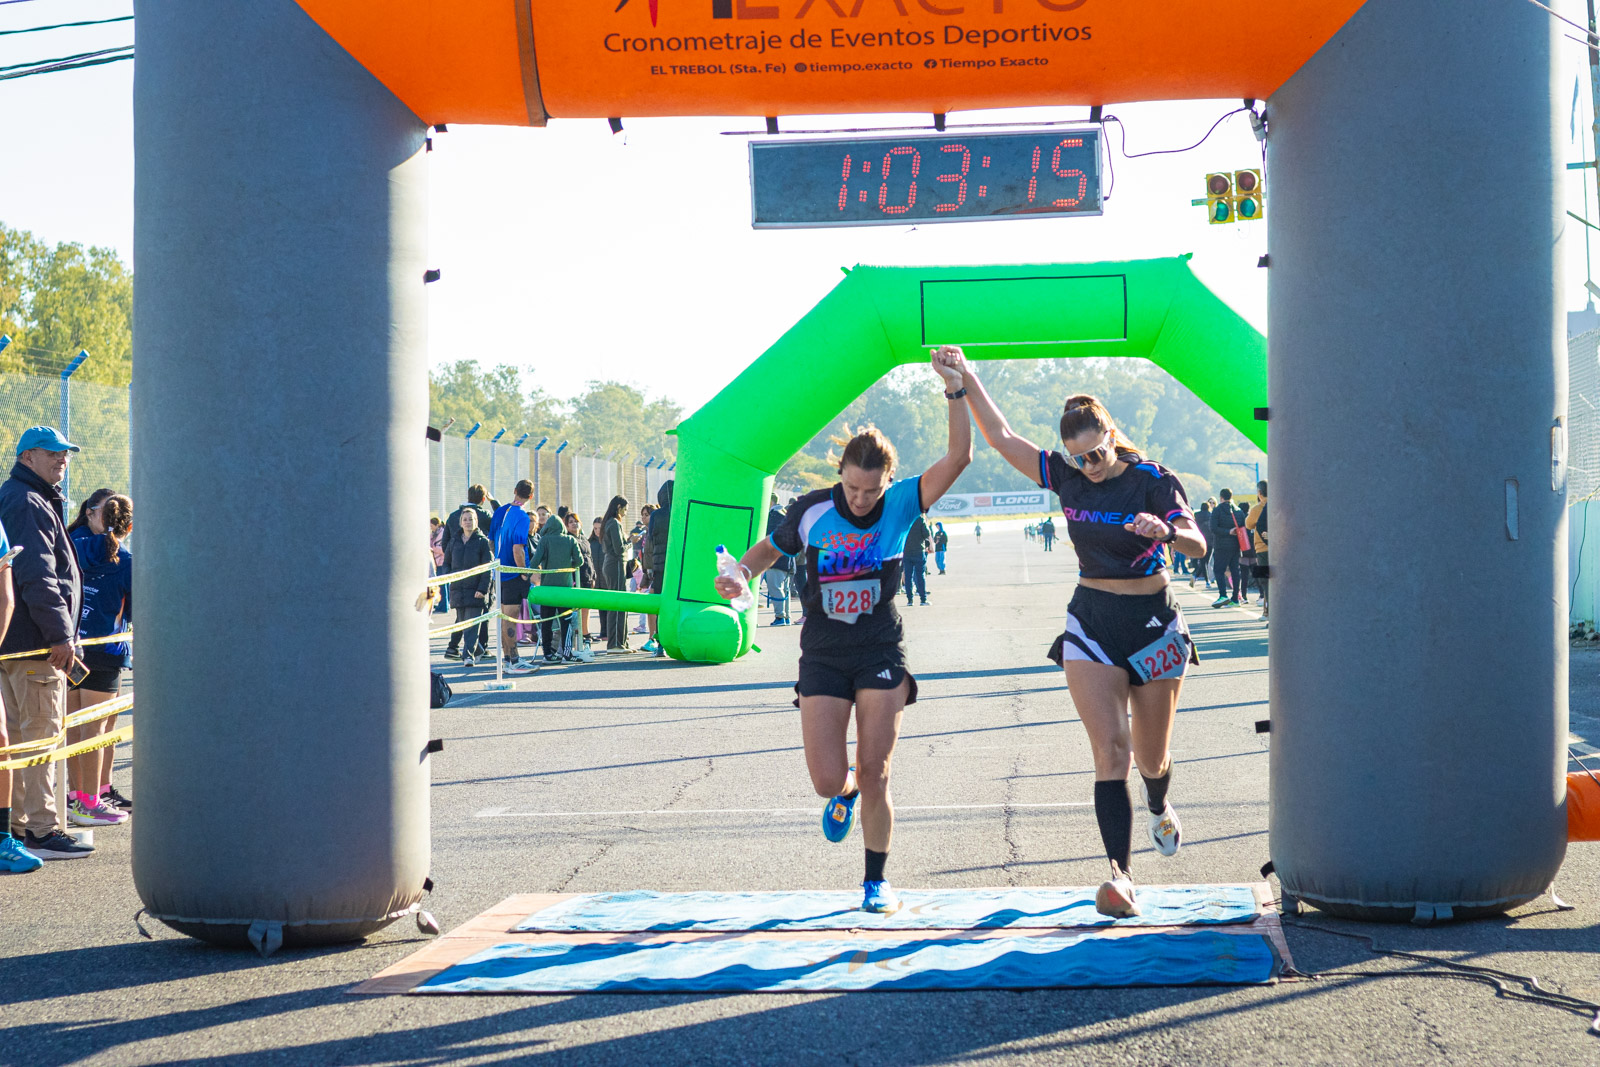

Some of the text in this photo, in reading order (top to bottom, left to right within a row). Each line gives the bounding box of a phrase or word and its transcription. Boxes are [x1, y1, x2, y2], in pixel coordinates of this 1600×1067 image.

[604, 23, 1092, 54] Cronometraje de Eventos Deportivos
[651, 57, 1049, 75] EL TREBOL (Sta. Fe) tiempo.exacto Tiempo Exacto
[937, 499, 961, 510] Ford
[995, 495, 1041, 505] LONG
[834, 589, 871, 613] 228
[1144, 643, 1182, 678] 223
